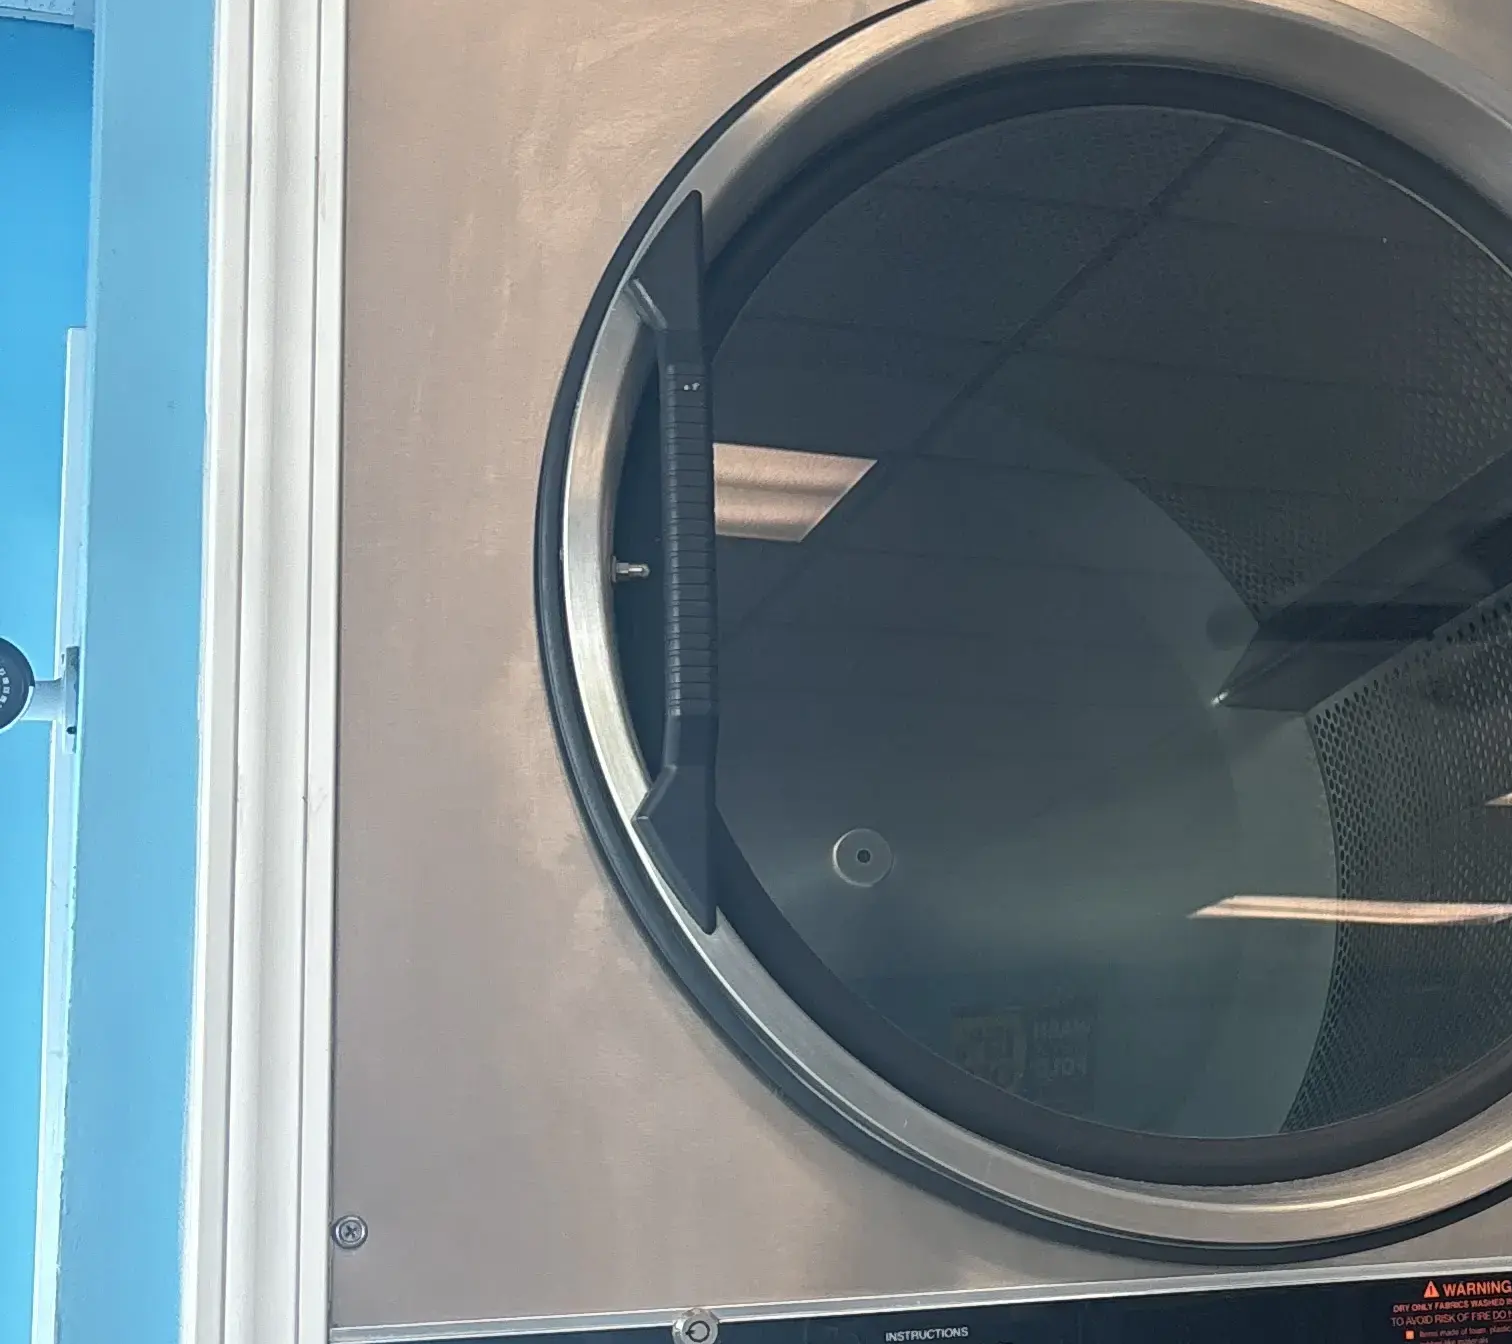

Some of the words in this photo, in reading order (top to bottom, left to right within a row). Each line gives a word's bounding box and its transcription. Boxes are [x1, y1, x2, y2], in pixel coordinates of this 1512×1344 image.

[1443, 1280, 1512, 1297] WARNING
[1393, 1304, 1410, 1313] DRY
[1412, 1303, 1433, 1311] ONLY
[1435, 1300, 1469, 1310] FABRICS
[1471, 1298, 1505, 1307] WASHED
[1391, 1316, 1404, 1326] TO
[1406, 1315, 1433, 1325] AVOID
[1435, 1314, 1454, 1323] RISK
[1457, 1312, 1470, 1322] OF
[1472, 1311, 1491, 1321] FIRE
[1493, 1310, 1506, 1320] DO
[885, 1327, 969, 1342] INSTRUCTIONS
